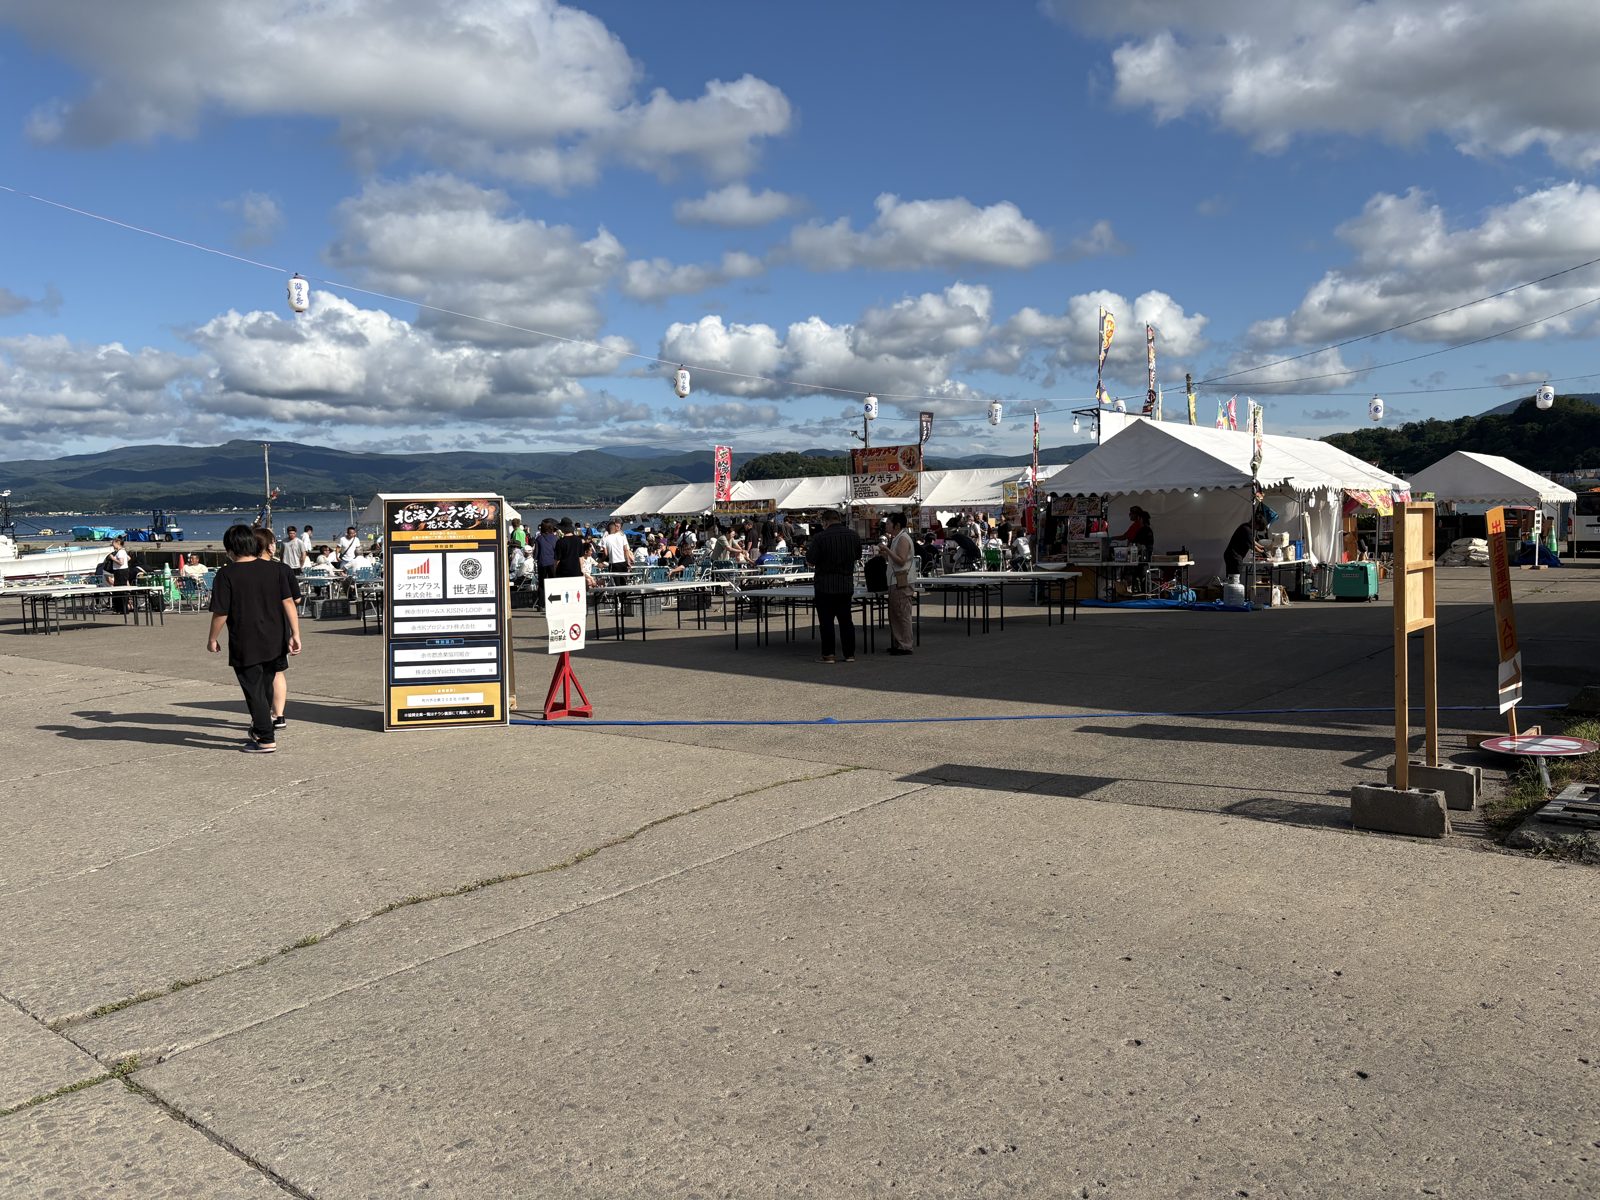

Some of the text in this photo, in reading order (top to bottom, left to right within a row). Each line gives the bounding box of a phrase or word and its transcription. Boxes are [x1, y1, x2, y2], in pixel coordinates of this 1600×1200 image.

[852, 474, 901, 484] ロングポテト
[394, 504, 488, 524] 北海ソーラン祭り
[427, 520, 464, 529] 花火大会
[397, 582, 440, 590] シフトプラス
[453, 584, 489, 595] 世壱屋
[1502, 618, 1514, 650] 入口
